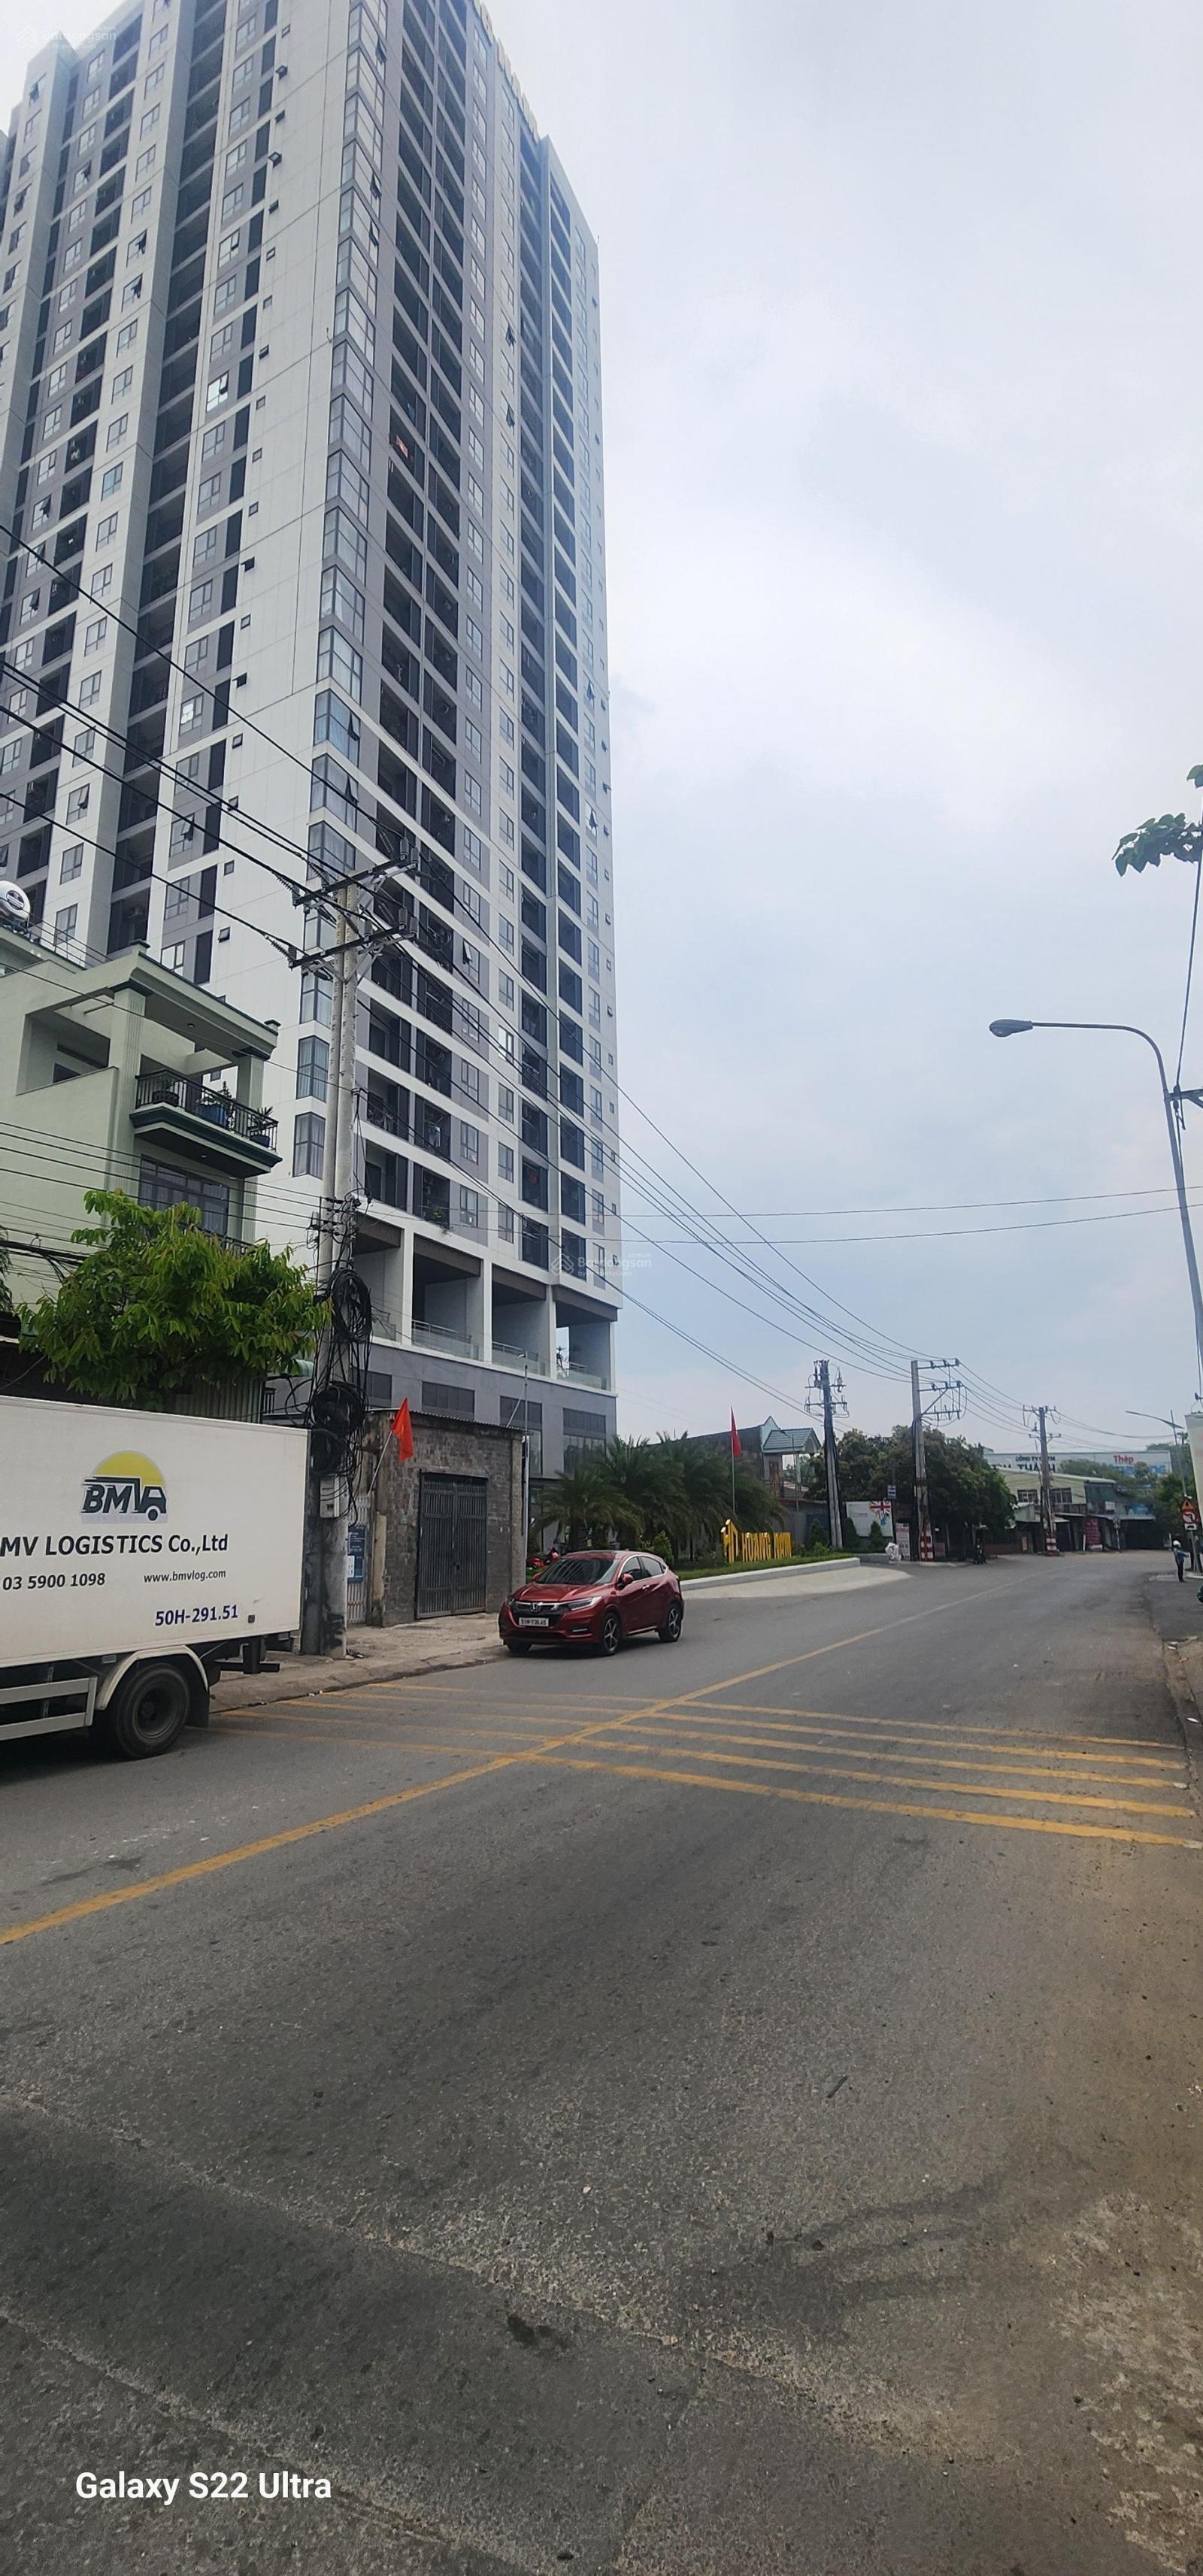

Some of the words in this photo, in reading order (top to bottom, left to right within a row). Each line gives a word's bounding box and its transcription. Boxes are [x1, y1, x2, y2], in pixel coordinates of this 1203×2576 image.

[45, 1535, 162, 1556] LOGISTICS
[168, 1533, 229, 1556] Co.,Ltd
[2, 1576, 22, 1591] 03
[27, 1574, 65, 1589] 5900
[70, 1572, 105, 1587] 1098
[144, 1569, 226, 1583] www.bmvlog.com
[155, 1604, 238, 1626] 50H-291.51
